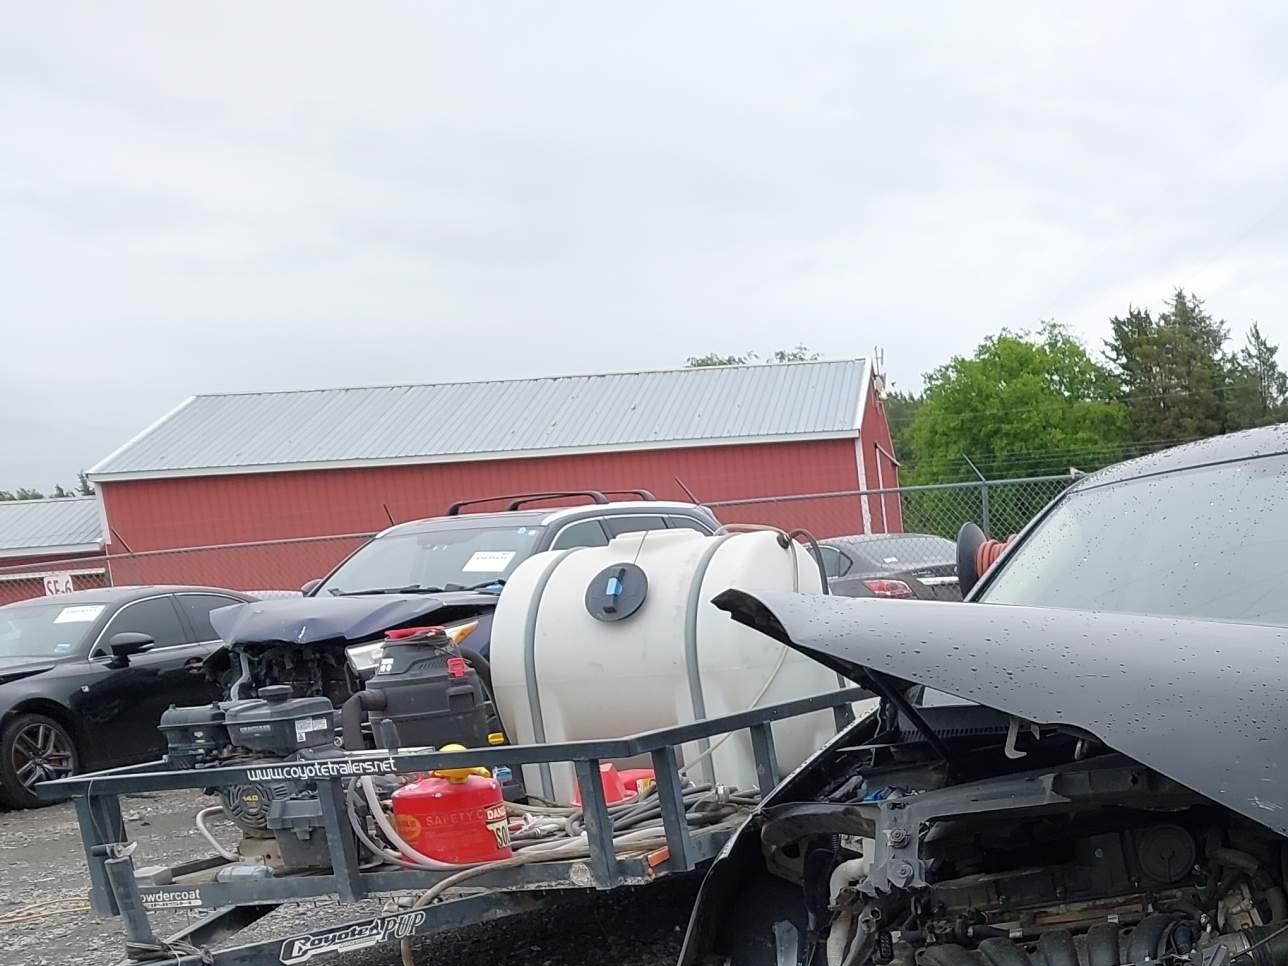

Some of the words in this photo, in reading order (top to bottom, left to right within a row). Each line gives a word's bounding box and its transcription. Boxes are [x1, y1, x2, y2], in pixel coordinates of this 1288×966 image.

[247, 757, 397, 781] www.coyotetrailers.net
[140, 889, 200, 903] owdercoat
[378, 911, 426, 943] PUP
